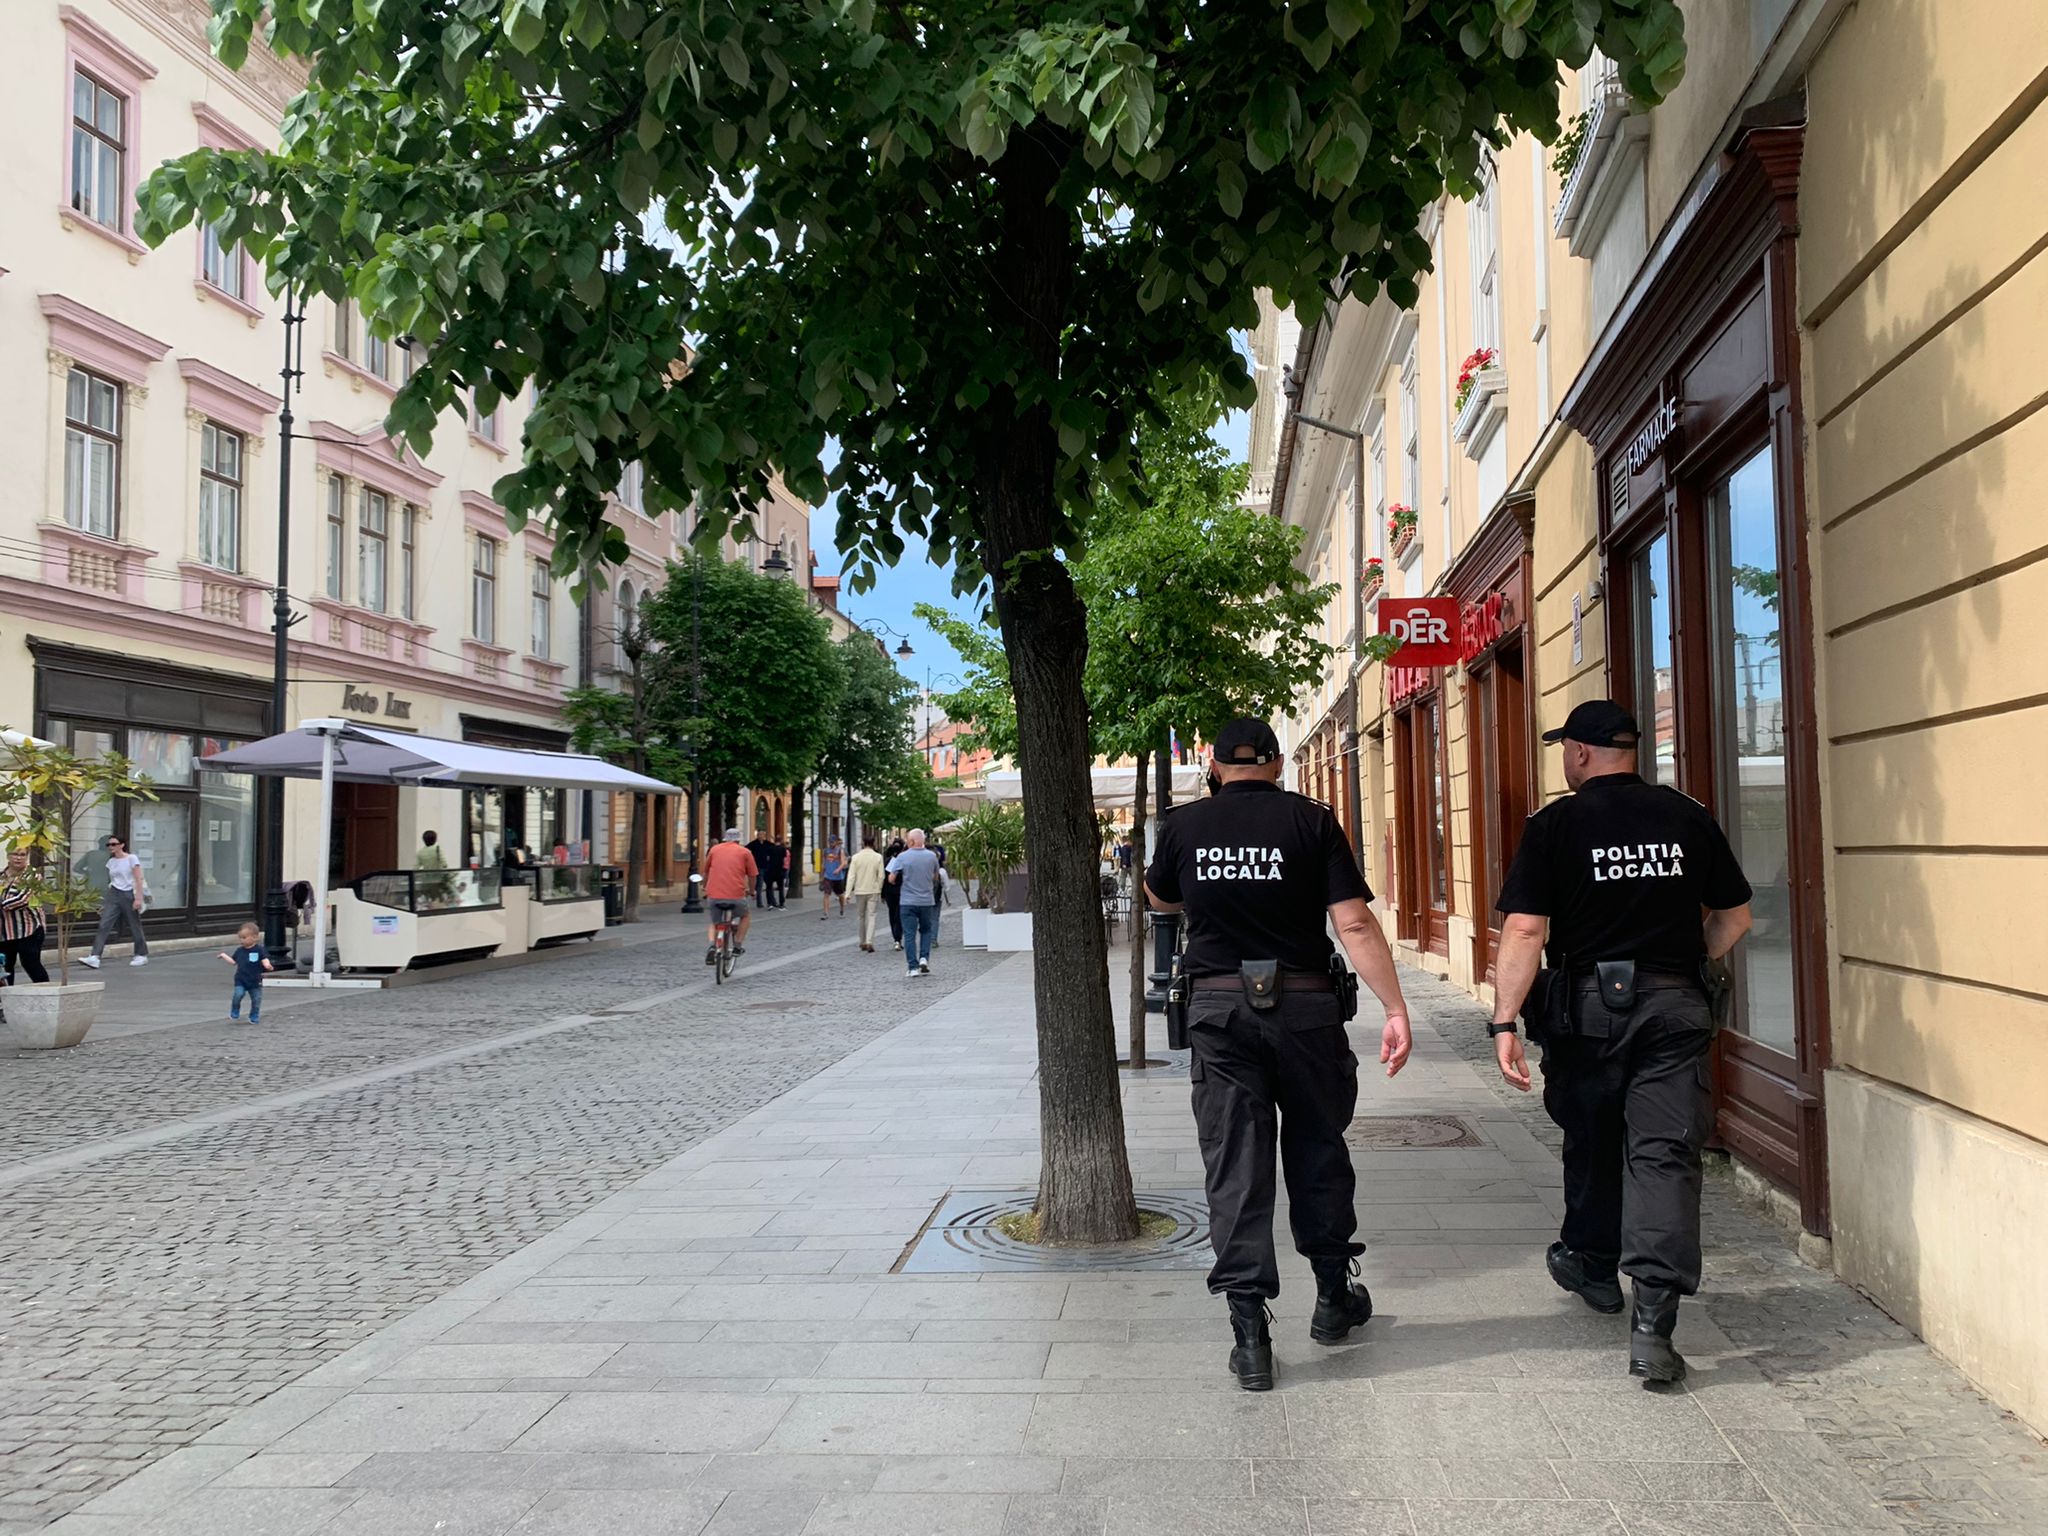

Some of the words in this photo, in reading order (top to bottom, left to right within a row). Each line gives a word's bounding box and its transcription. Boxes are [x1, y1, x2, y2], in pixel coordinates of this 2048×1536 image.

[1627, 395, 1677, 477] FARMACIE
[1389, 616, 1450, 644] DER
[1196, 862, 1283, 881] LOCALĂ
[1593, 858, 1684, 882] LOCALĂ
